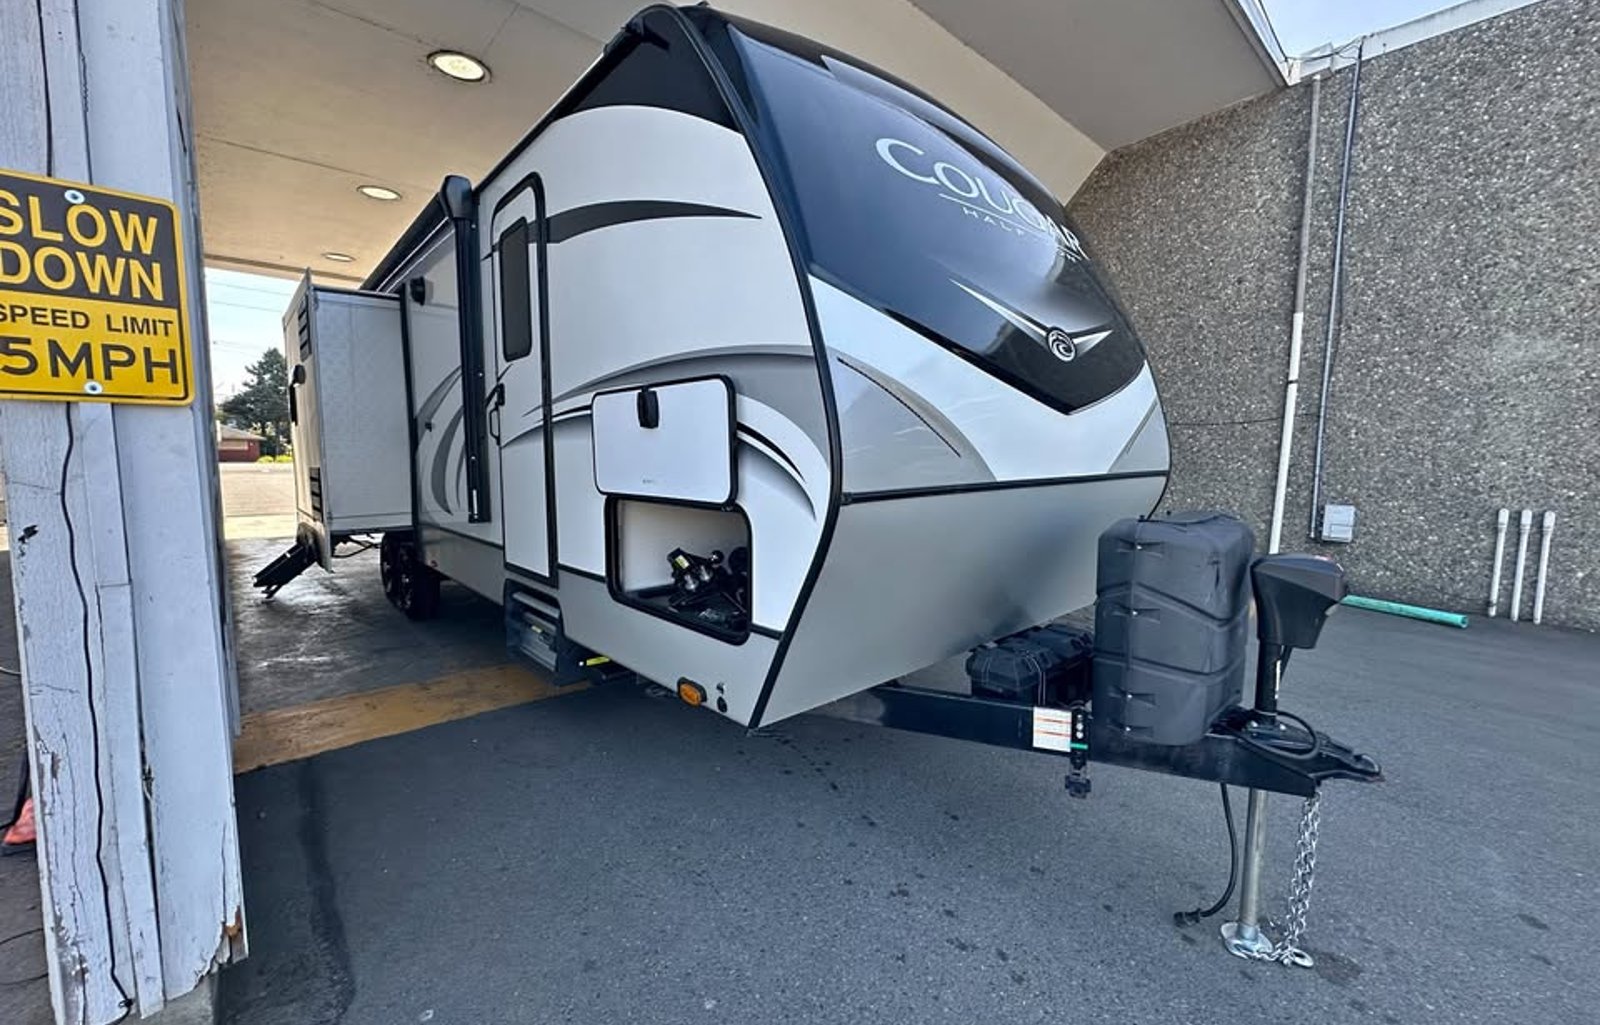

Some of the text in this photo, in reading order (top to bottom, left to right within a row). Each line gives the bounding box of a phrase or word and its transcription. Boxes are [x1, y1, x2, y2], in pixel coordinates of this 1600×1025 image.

[0, 189, 158, 255] SLOW
[0, 240, 164, 301] DOWN
[106, 313, 174, 337] LIMIT
